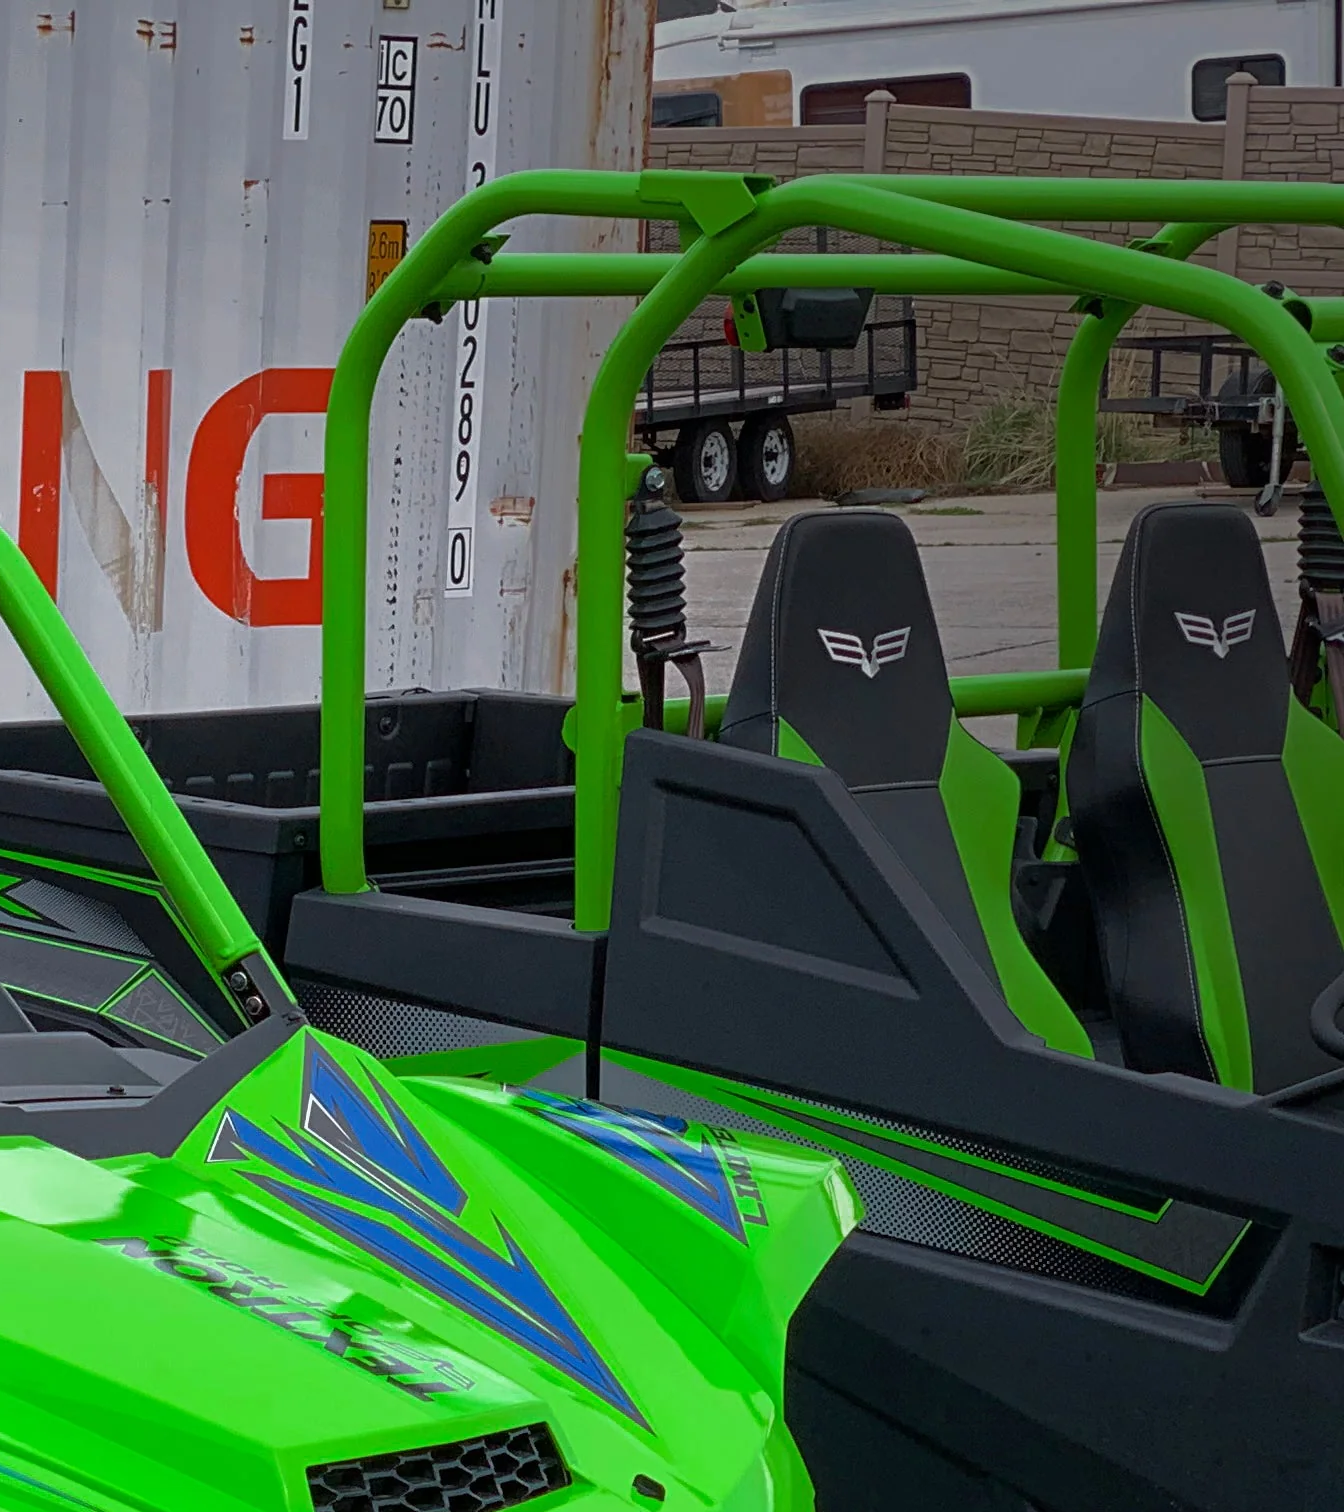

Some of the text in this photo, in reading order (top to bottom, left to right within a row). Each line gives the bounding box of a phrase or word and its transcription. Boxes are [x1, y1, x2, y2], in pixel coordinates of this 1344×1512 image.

[290, 0, 310, 133] G1
[376, 95, 407, 134] 70
[702, 1123, 770, 1227] LIMITE
[153, 1234, 289, 1291] ROAD
[90, 1236, 458, 1402] TEXTRON
